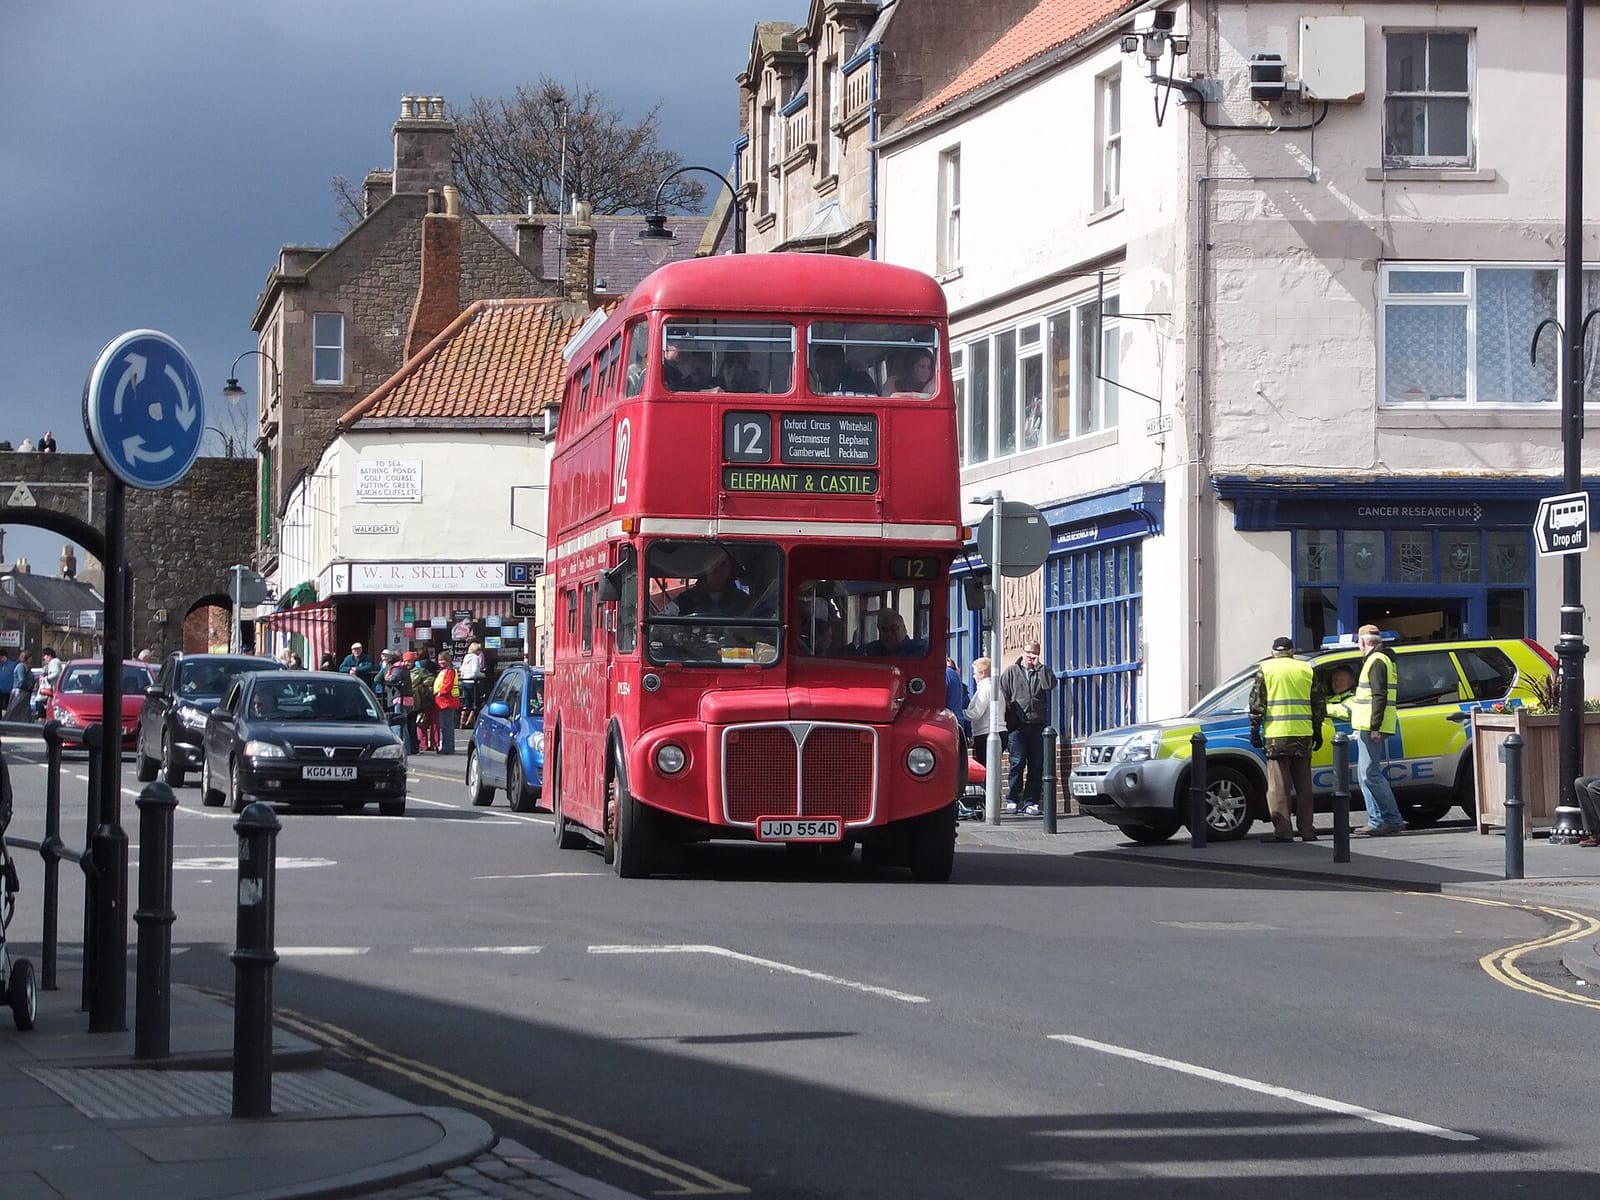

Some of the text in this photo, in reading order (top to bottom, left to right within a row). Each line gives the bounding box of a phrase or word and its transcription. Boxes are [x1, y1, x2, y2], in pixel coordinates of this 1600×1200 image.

[784, 419, 873, 432] Oxford Circus Whitehall
[733, 422, 763, 454] 12
[788, 432, 869, 446] Westminster Elephant
[788, 446, 869, 459] Camberwell Peckham
[360, 467, 389, 475] BATHING
[730, 472, 871, 493] ELEPHANT & CASTLE
[1358, 506, 1472, 517] CANCER RESEARCH UK
[1553, 530, 1582, 547] Drop off
[362, 566, 382, 579] W.
[391, 566, 405, 579] R.
[412, 566, 467, 579] SKELLY
[475, 566, 488, 579] &
[514, 566, 524, 579] P
[907, 559, 925, 577] 12
[1004, 573, 1042, 618] RUM
[306, 767, 354, 777] KG04 LXR
[763, 822, 838, 836] JJD 554D
